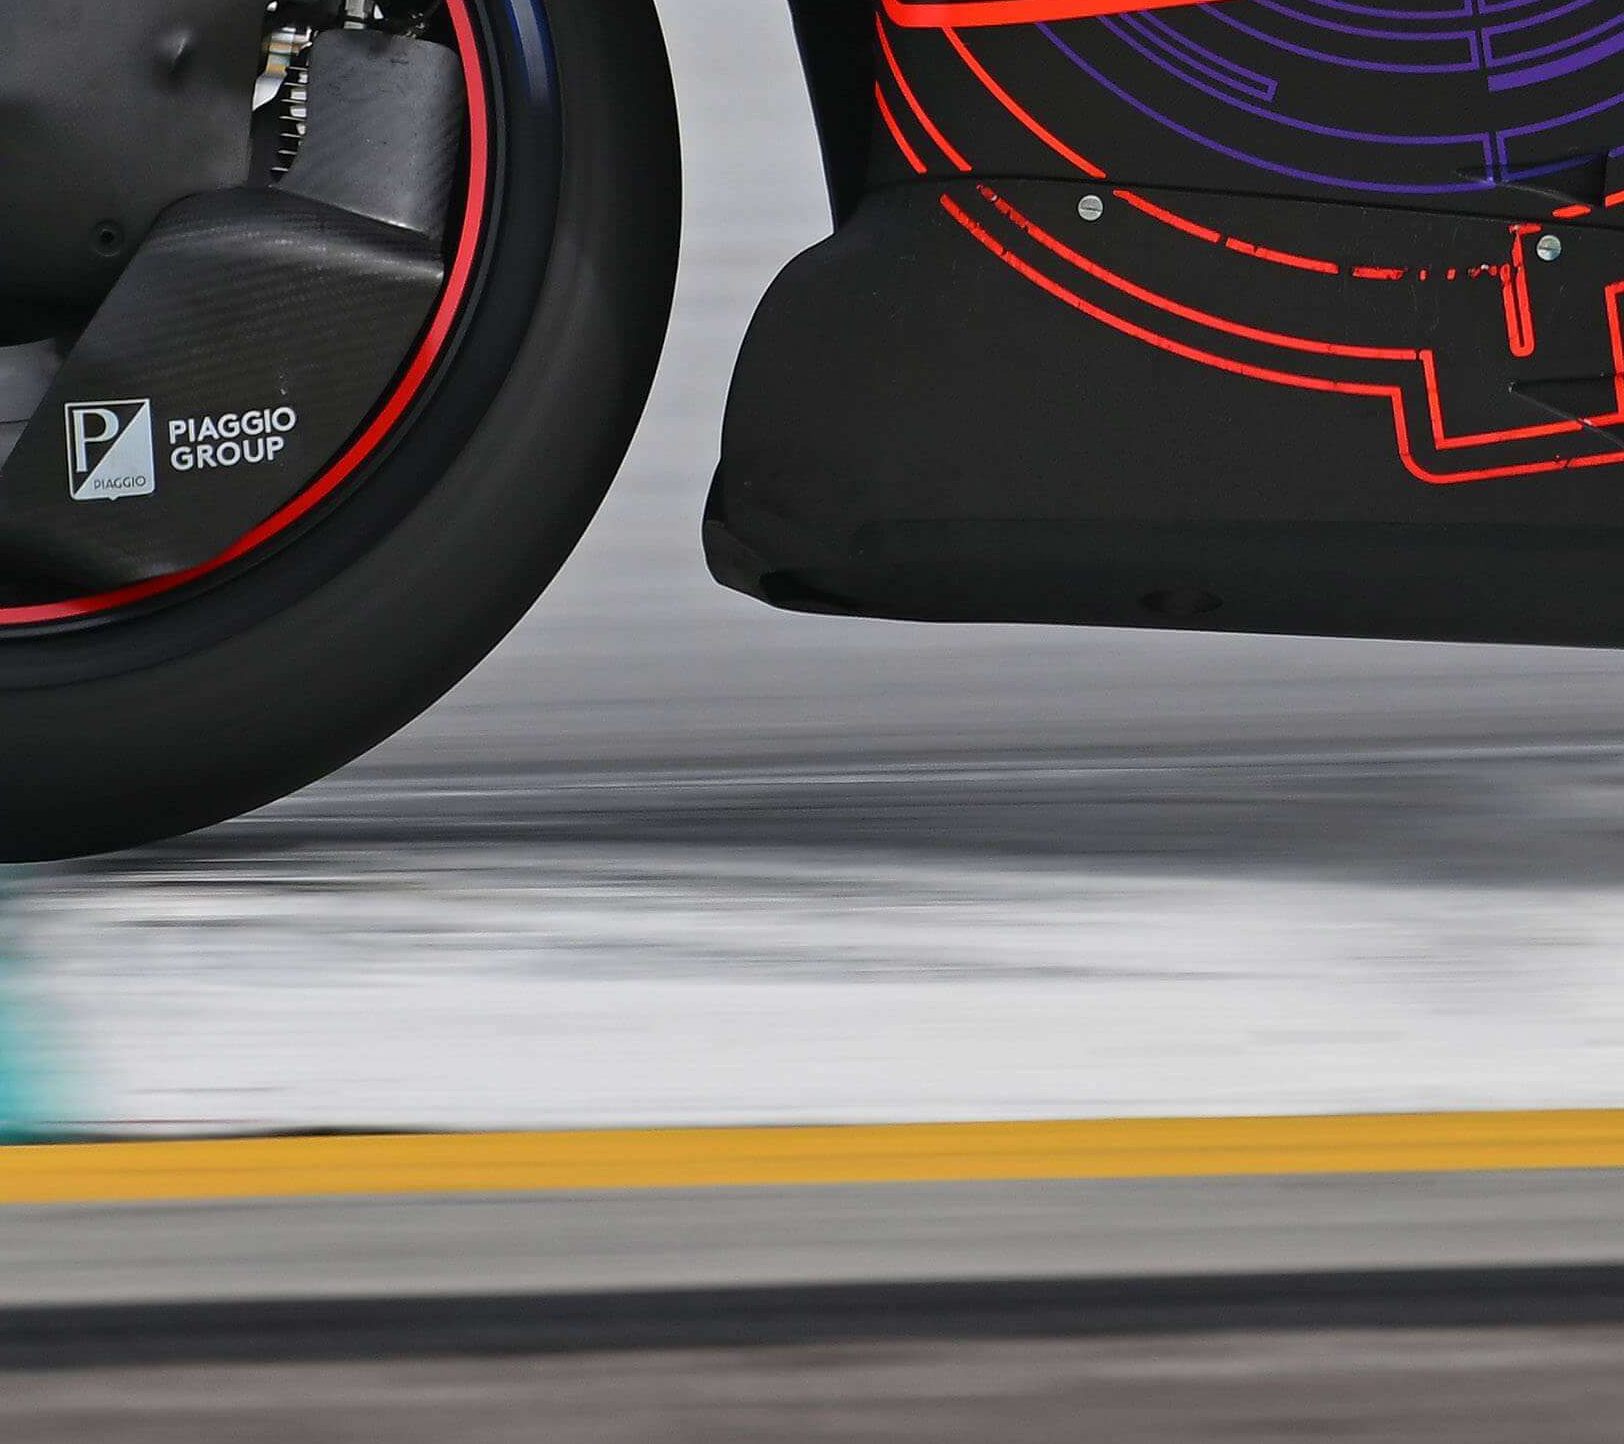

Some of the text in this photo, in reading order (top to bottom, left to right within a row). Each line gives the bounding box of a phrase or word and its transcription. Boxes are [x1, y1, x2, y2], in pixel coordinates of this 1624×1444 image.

[72, 407, 120, 473] P
[168, 406, 297, 445] PIAGGIO
[170, 436, 285, 472] GROUP
[93, 474, 147, 491] PIAGGIO
